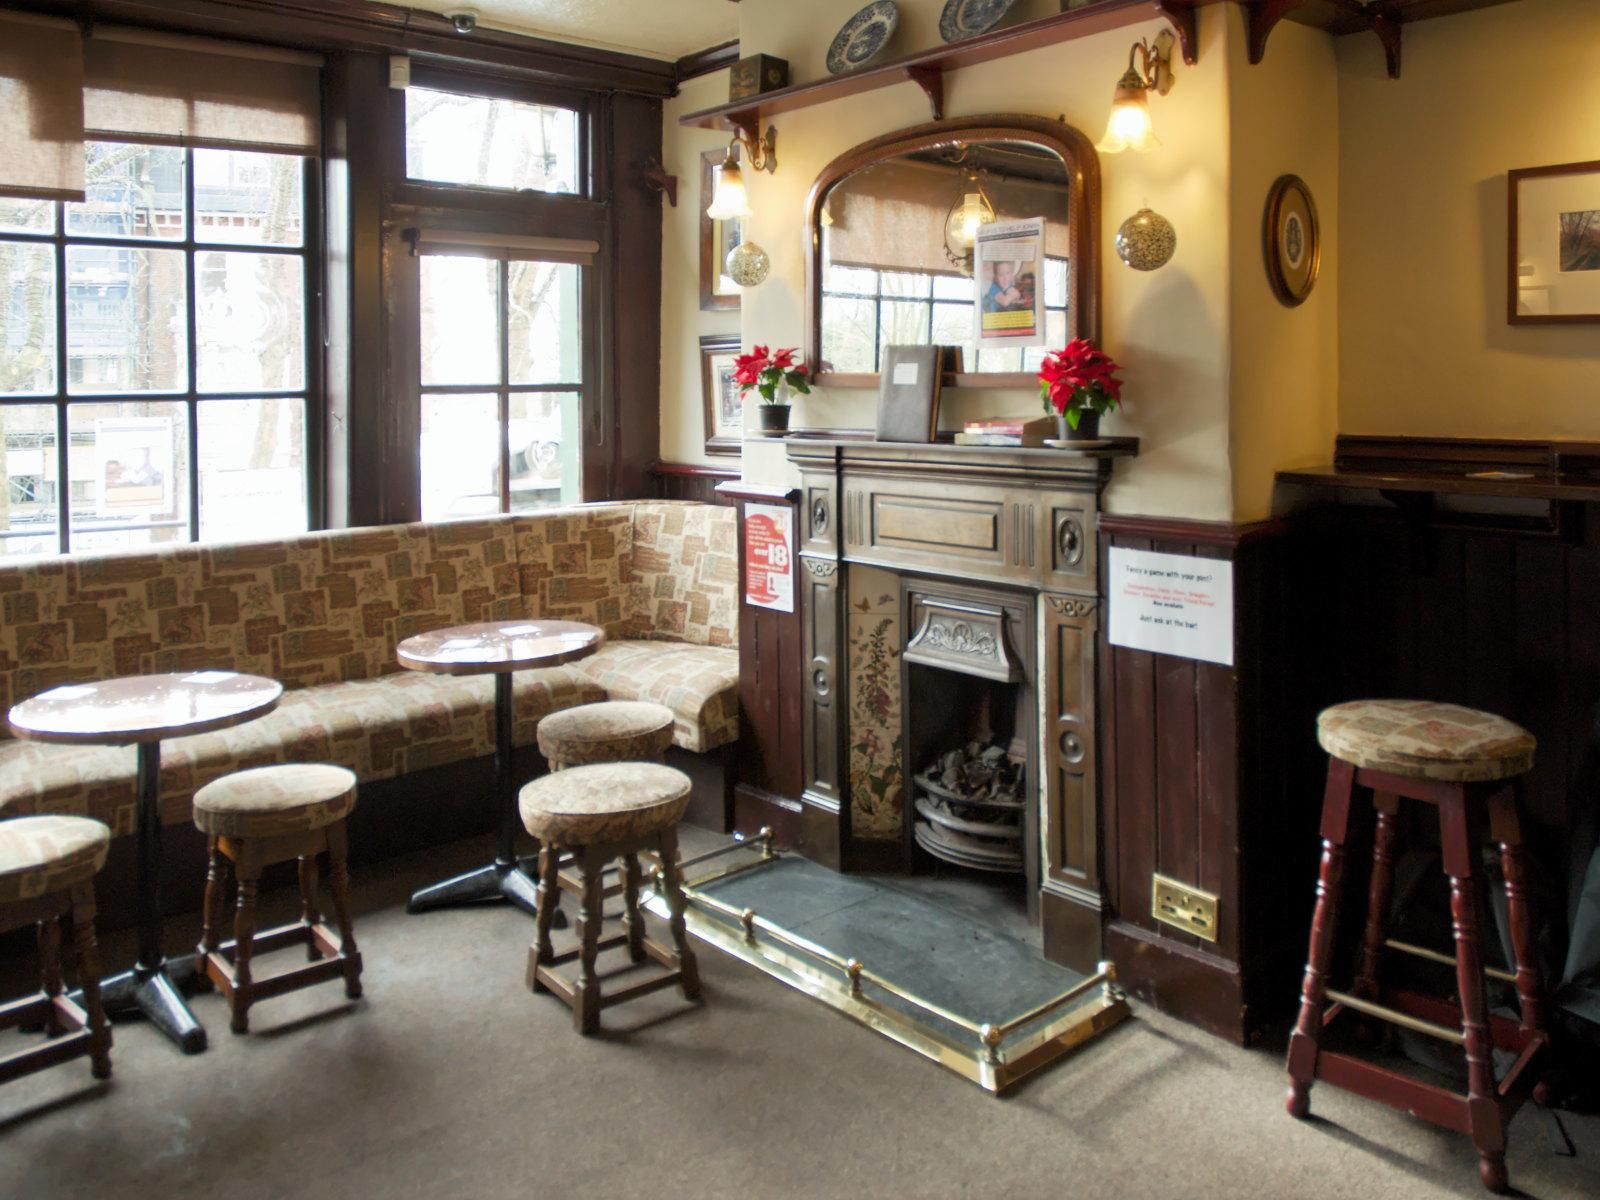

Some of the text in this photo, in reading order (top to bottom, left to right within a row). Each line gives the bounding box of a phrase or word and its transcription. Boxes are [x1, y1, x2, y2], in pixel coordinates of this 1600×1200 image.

[768, 543, 788, 567] 18
[1166, 570, 1180, 578] with
[1181, 573, 1195, 581] your
[1140, 614, 1153, 622] Just
[1154, 615, 1164, 624] ask
[1174, 618, 1184, 627] the
